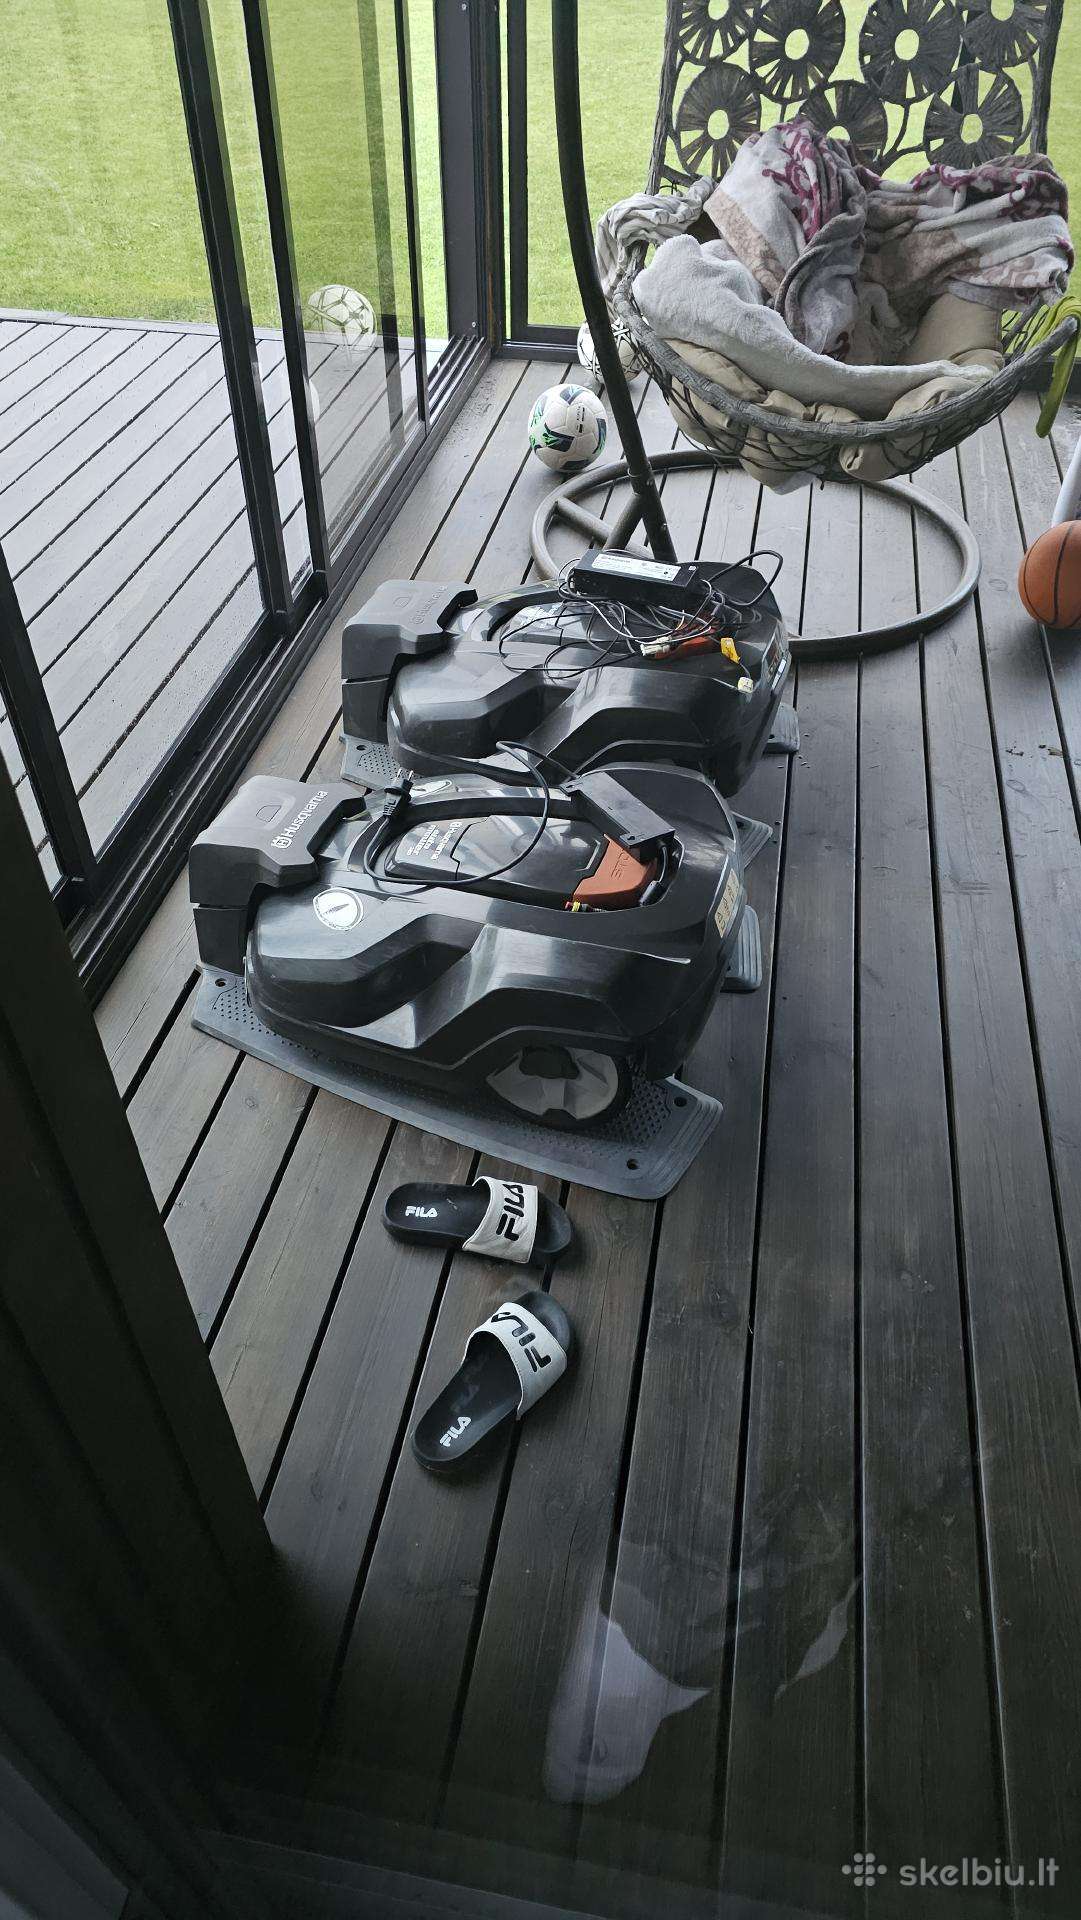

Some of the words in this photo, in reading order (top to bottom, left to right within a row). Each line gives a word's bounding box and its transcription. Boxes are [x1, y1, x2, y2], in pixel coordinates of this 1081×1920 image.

[281, 791, 328, 838] Husqvarna
[405, 1205, 438, 1218] FILA
[496, 1183, 525, 1242] FILA
[490, 1311, 552, 1373] FILA
[439, 1416, 472, 1447] FILA
